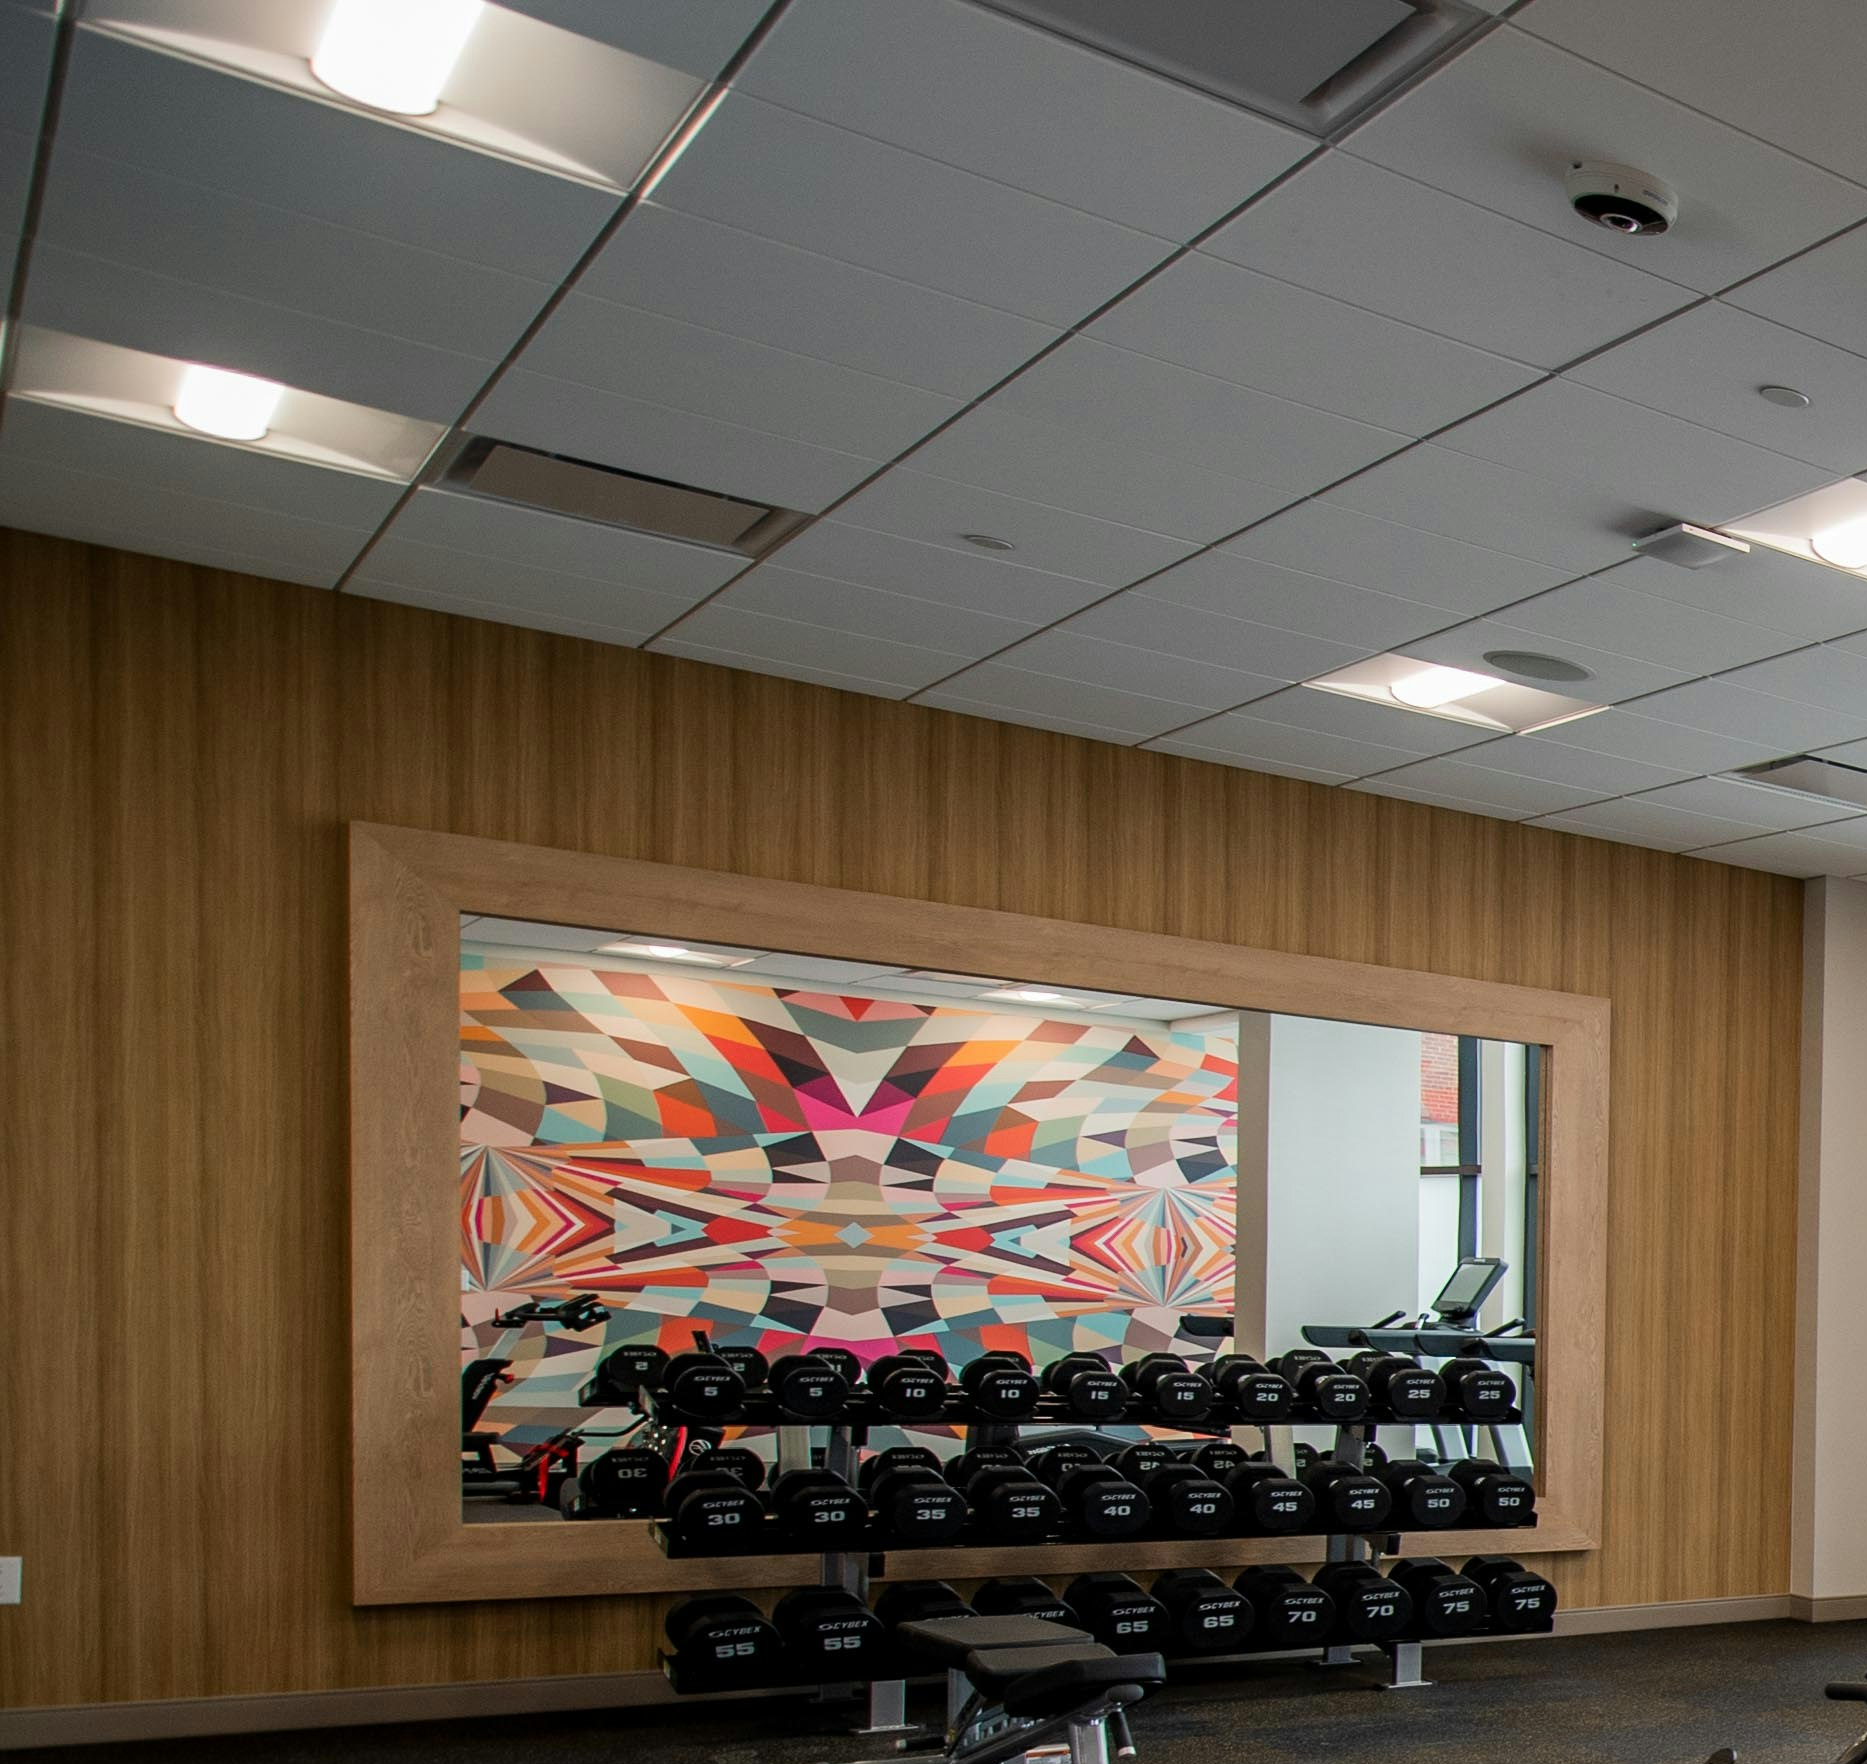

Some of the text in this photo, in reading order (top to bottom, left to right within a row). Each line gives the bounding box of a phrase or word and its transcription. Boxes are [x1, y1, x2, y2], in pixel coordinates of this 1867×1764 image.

[704, 1386, 718, 1397] 5
[809, 1387, 823, 1397] 5
[905, 1388, 926, 1398] 10
[1000, 1388, 1020, 1399] 10
[1090, 1391, 1109, 1401] 15
[1176, 1391, 1194, 1401] 15
[1256, 1392, 1279, 1402] 20
[1408, 1389, 1431, 1399] 25
[1478, 1390, 1500, 1400] 25
[1334, 1393, 1356, 1403] 20
[1272, 1502, 1298, 1512] 45
[1350, 1499, 1376, 1509] 45
[1427, 1498, 1451, 1508] 50
[1498, 1497, 1521, 1507] 50
[916, 1508, 947, 1520] 35
[1011, 1507, 1040, 1519] 35
[1104, 1505, 1131, 1516] 40
[1189, 1503, 1216, 1514] 40
[707, 1513, 741, 1525] 30
[814, 1510, 846, 1523] 30
[1442, 1601, 1470, 1615] 75
[1514, 1597, 1540, 1611] 75
[1287, 1610, 1317, 1623] 70
[1366, 1604, 1394, 1618] 70
[832, 1620, 869, 1630] CYBEX
[1116, 1620, 1149, 1634] 65
[1203, 1615, 1235, 1629] 65
[724, 1625, 762, 1636] CYBEX
[823, 1635, 862, 1651] 55
[714, 1641, 755, 1659] 55
